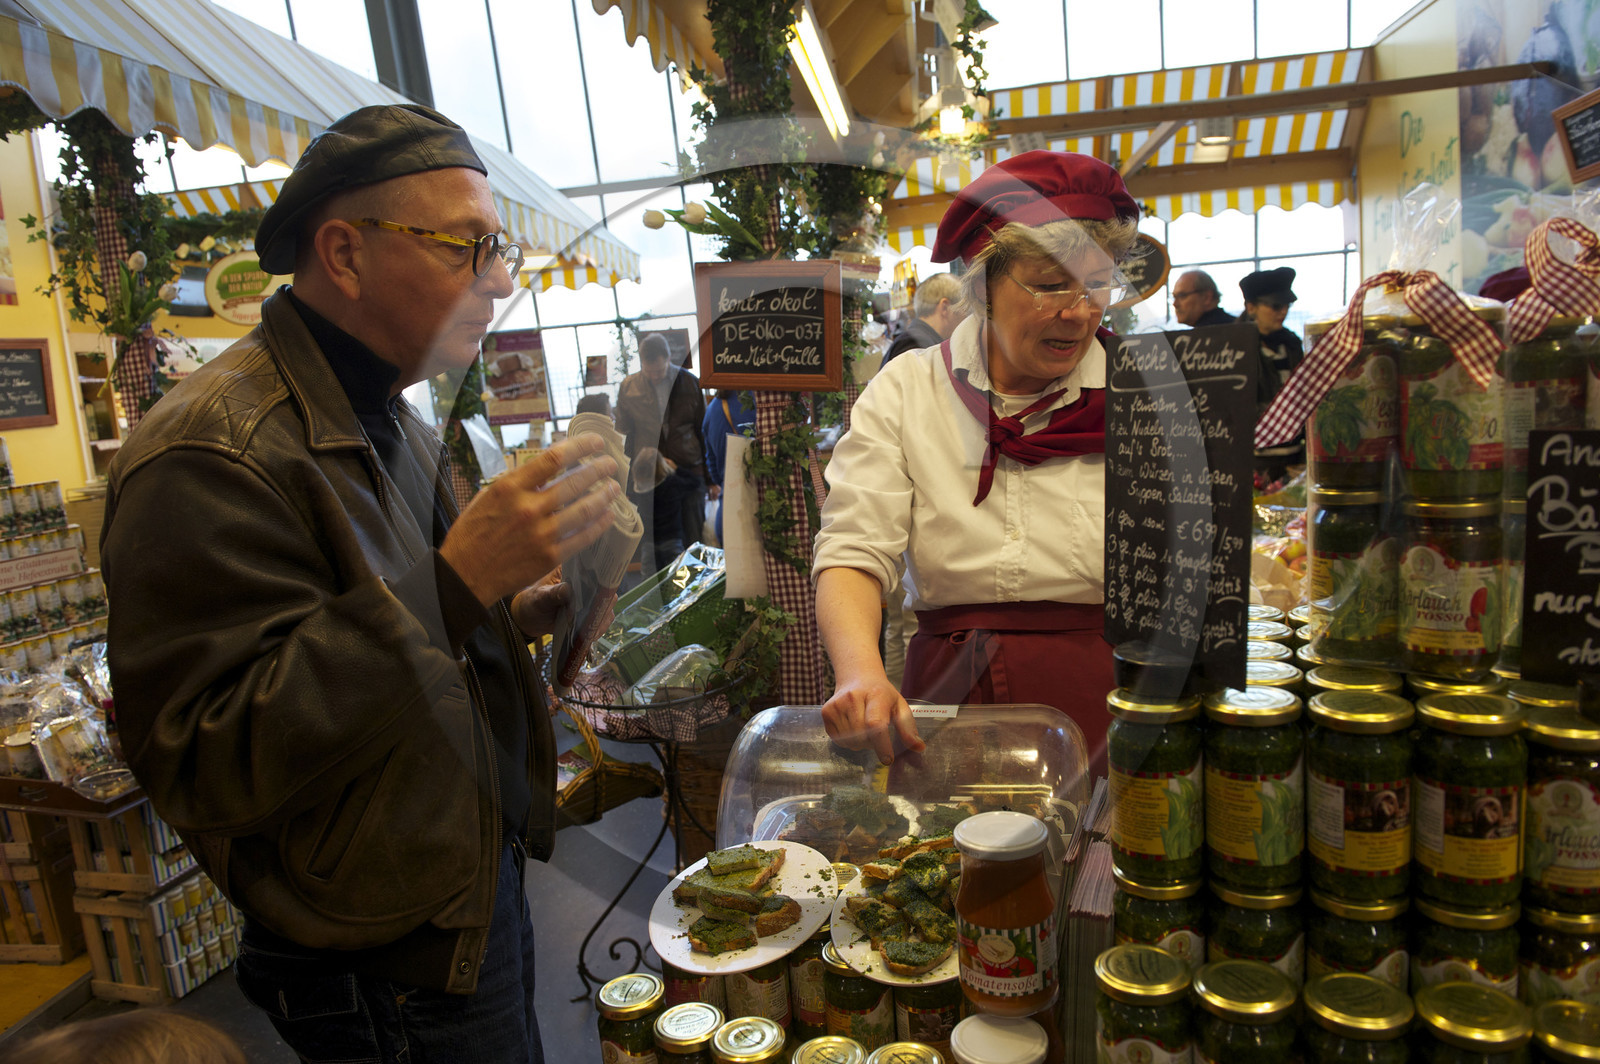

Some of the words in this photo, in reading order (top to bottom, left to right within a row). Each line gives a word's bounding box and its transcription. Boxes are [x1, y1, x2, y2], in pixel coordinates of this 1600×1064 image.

[718, 286, 766, 313] kontr.
[769, 285, 817, 312] ökol.
[720, 318, 823, 343] DE-ÖKO-037
[715, 347, 743, 365] ohne
[1113, 339, 1168, 372] Frische
[1172, 335, 1245, 374] Kräuter
[1182, 468, 1193, 484] in
[1107, 533, 1117, 553] 3
[1108, 558, 1116, 577] 4
[1108, 580, 1116, 598] 6
[1105, 601, 1118, 619] 10
[1167, 617, 1176, 635] 2
[1416, 610, 1466, 623] rosso
[963, 967, 1039, 993] Tomatensoße
